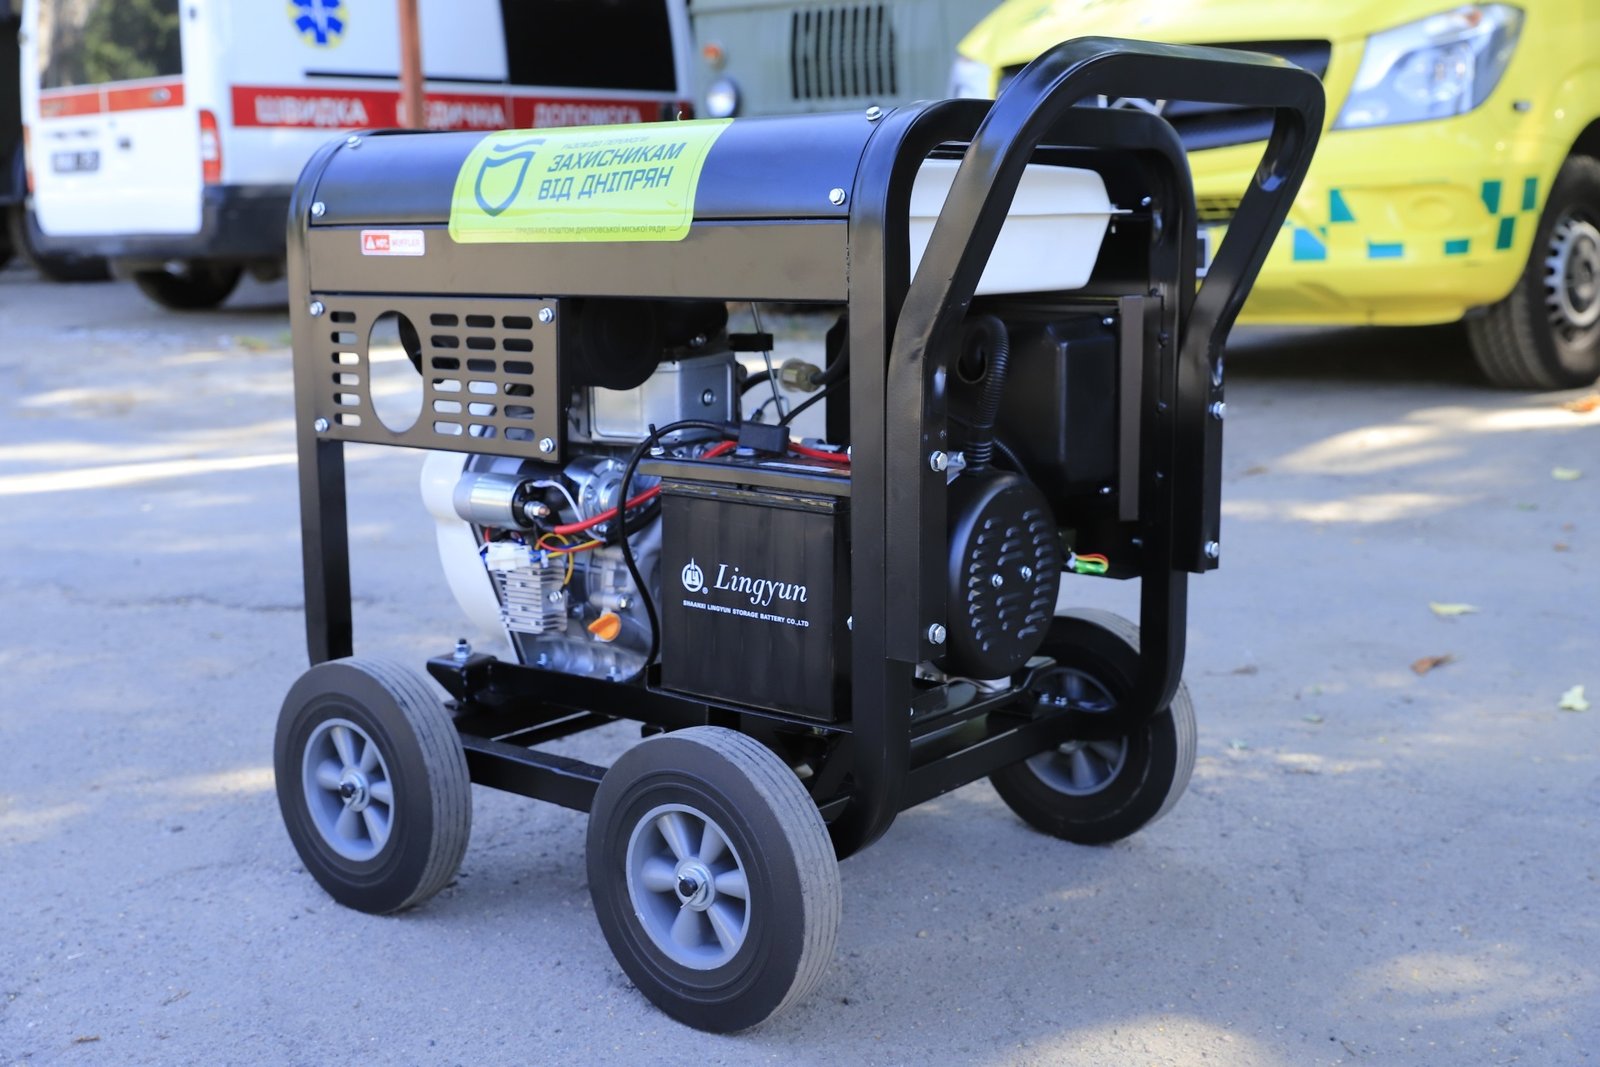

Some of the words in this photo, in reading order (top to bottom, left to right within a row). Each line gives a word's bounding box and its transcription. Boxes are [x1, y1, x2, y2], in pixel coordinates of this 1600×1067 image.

[254, 95, 369, 124] ШВИДКА
[396, 100, 506, 130] ДИЧНА
[533, 103, 642, 127] ДОПОМОГА
[547, 142, 686, 172] ЗАХИСНИКАМ
[538, 176, 574, 202] ВІД
[577, 166, 675, 200] ДНІПРЯН
[621, 224, 648, 233] МІСЬКОЇ
[648, 225, 666, 234] РАДИ
[713, 563, 808, 607] Lingyun
[707, 603, 731, 614] LINGYUN
[732, 608, 759, 619] STORAGE
[760, 613, 785, 623] BATTERY
